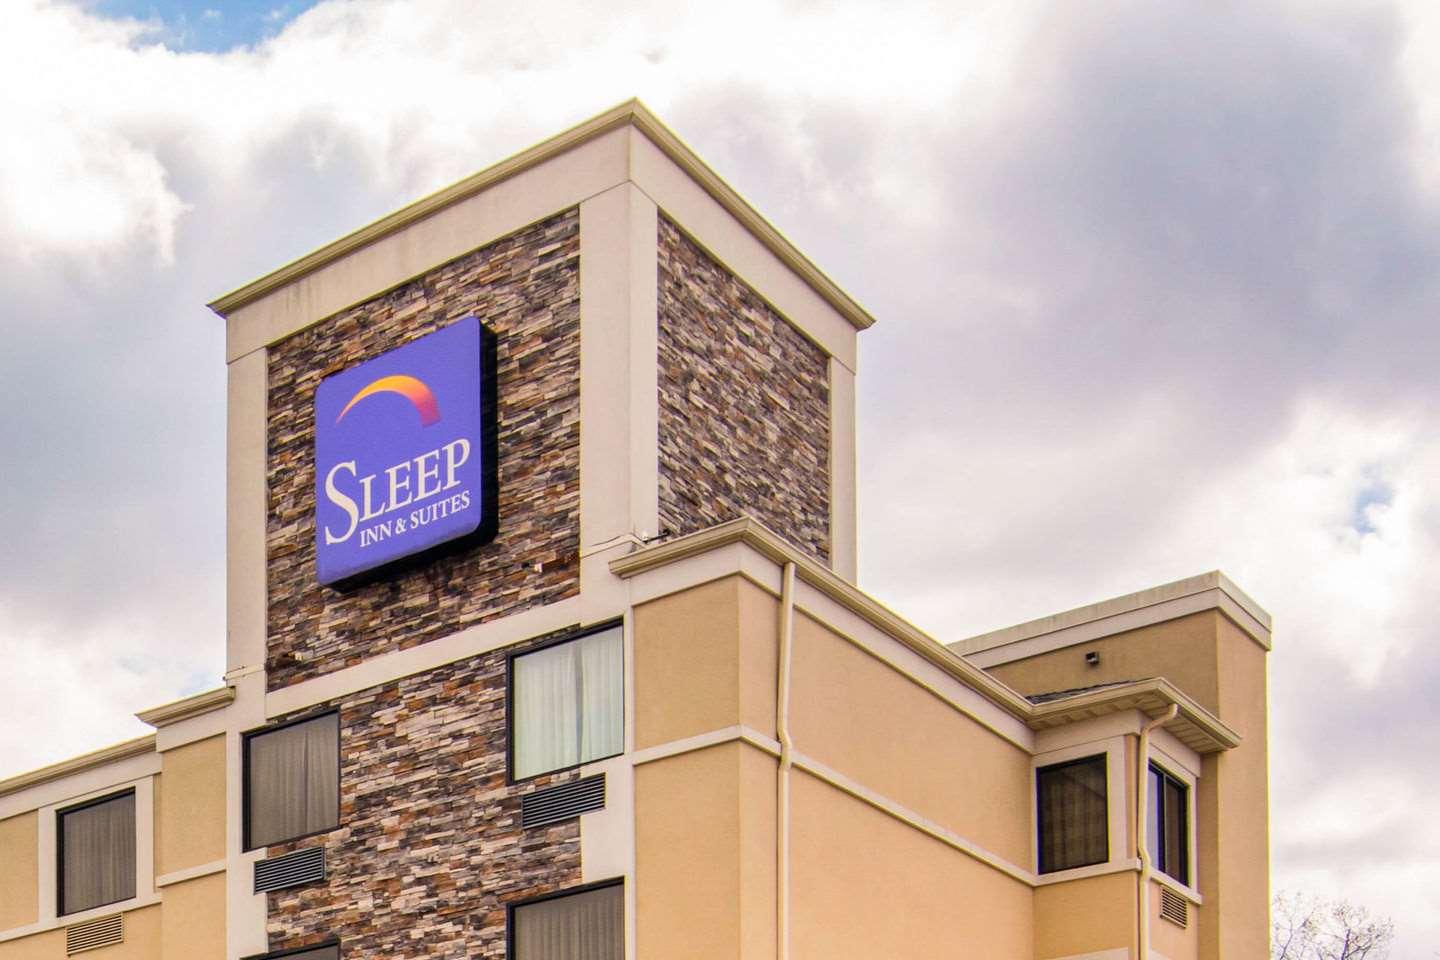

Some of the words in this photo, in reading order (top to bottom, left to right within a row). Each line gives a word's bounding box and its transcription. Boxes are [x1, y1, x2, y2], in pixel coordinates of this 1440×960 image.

[324, 438, 471, 545] SLEEP
[360, 520, 392, 547] INN
[395, 517, 407, 535] &
[410, 490, 471, 530] SUITES
